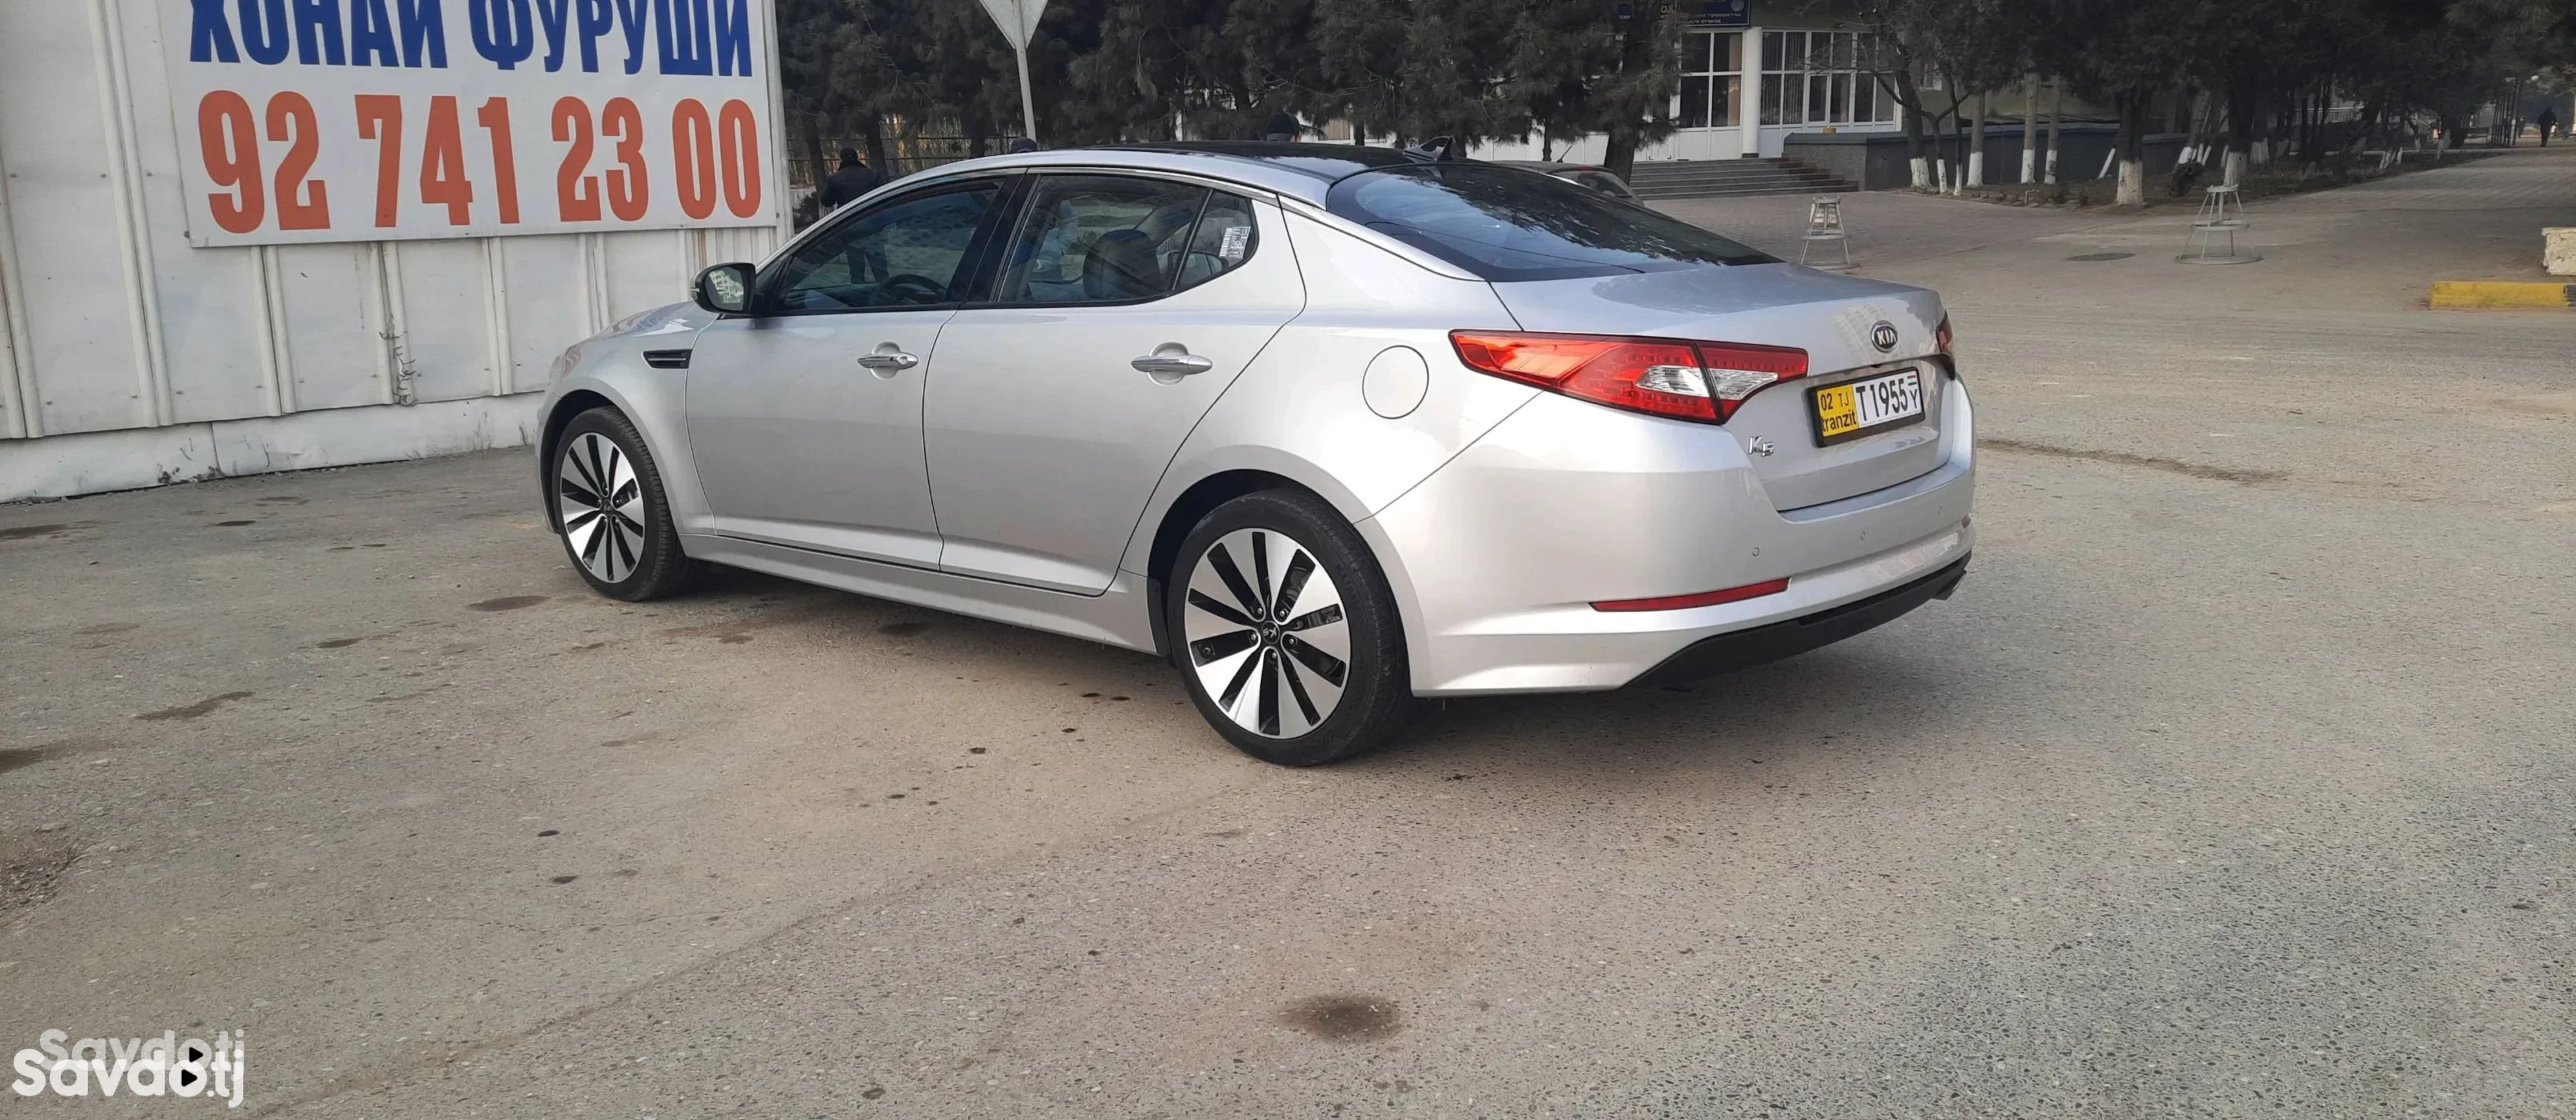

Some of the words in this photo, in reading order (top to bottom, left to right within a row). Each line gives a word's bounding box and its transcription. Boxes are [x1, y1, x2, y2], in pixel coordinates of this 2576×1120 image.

[198, 90, 330, 234] 92
[354, 94, 520, 228] 741
[551, 96, 649, 222] 23
[672, 99, 761, 219] 00
[1876, 329, 1897, 345] KIA
[1820, 393, 1834, 411] 02
[1838, 392, 1850, 407] TJ
[1748, 435, 1774, 457] K5
